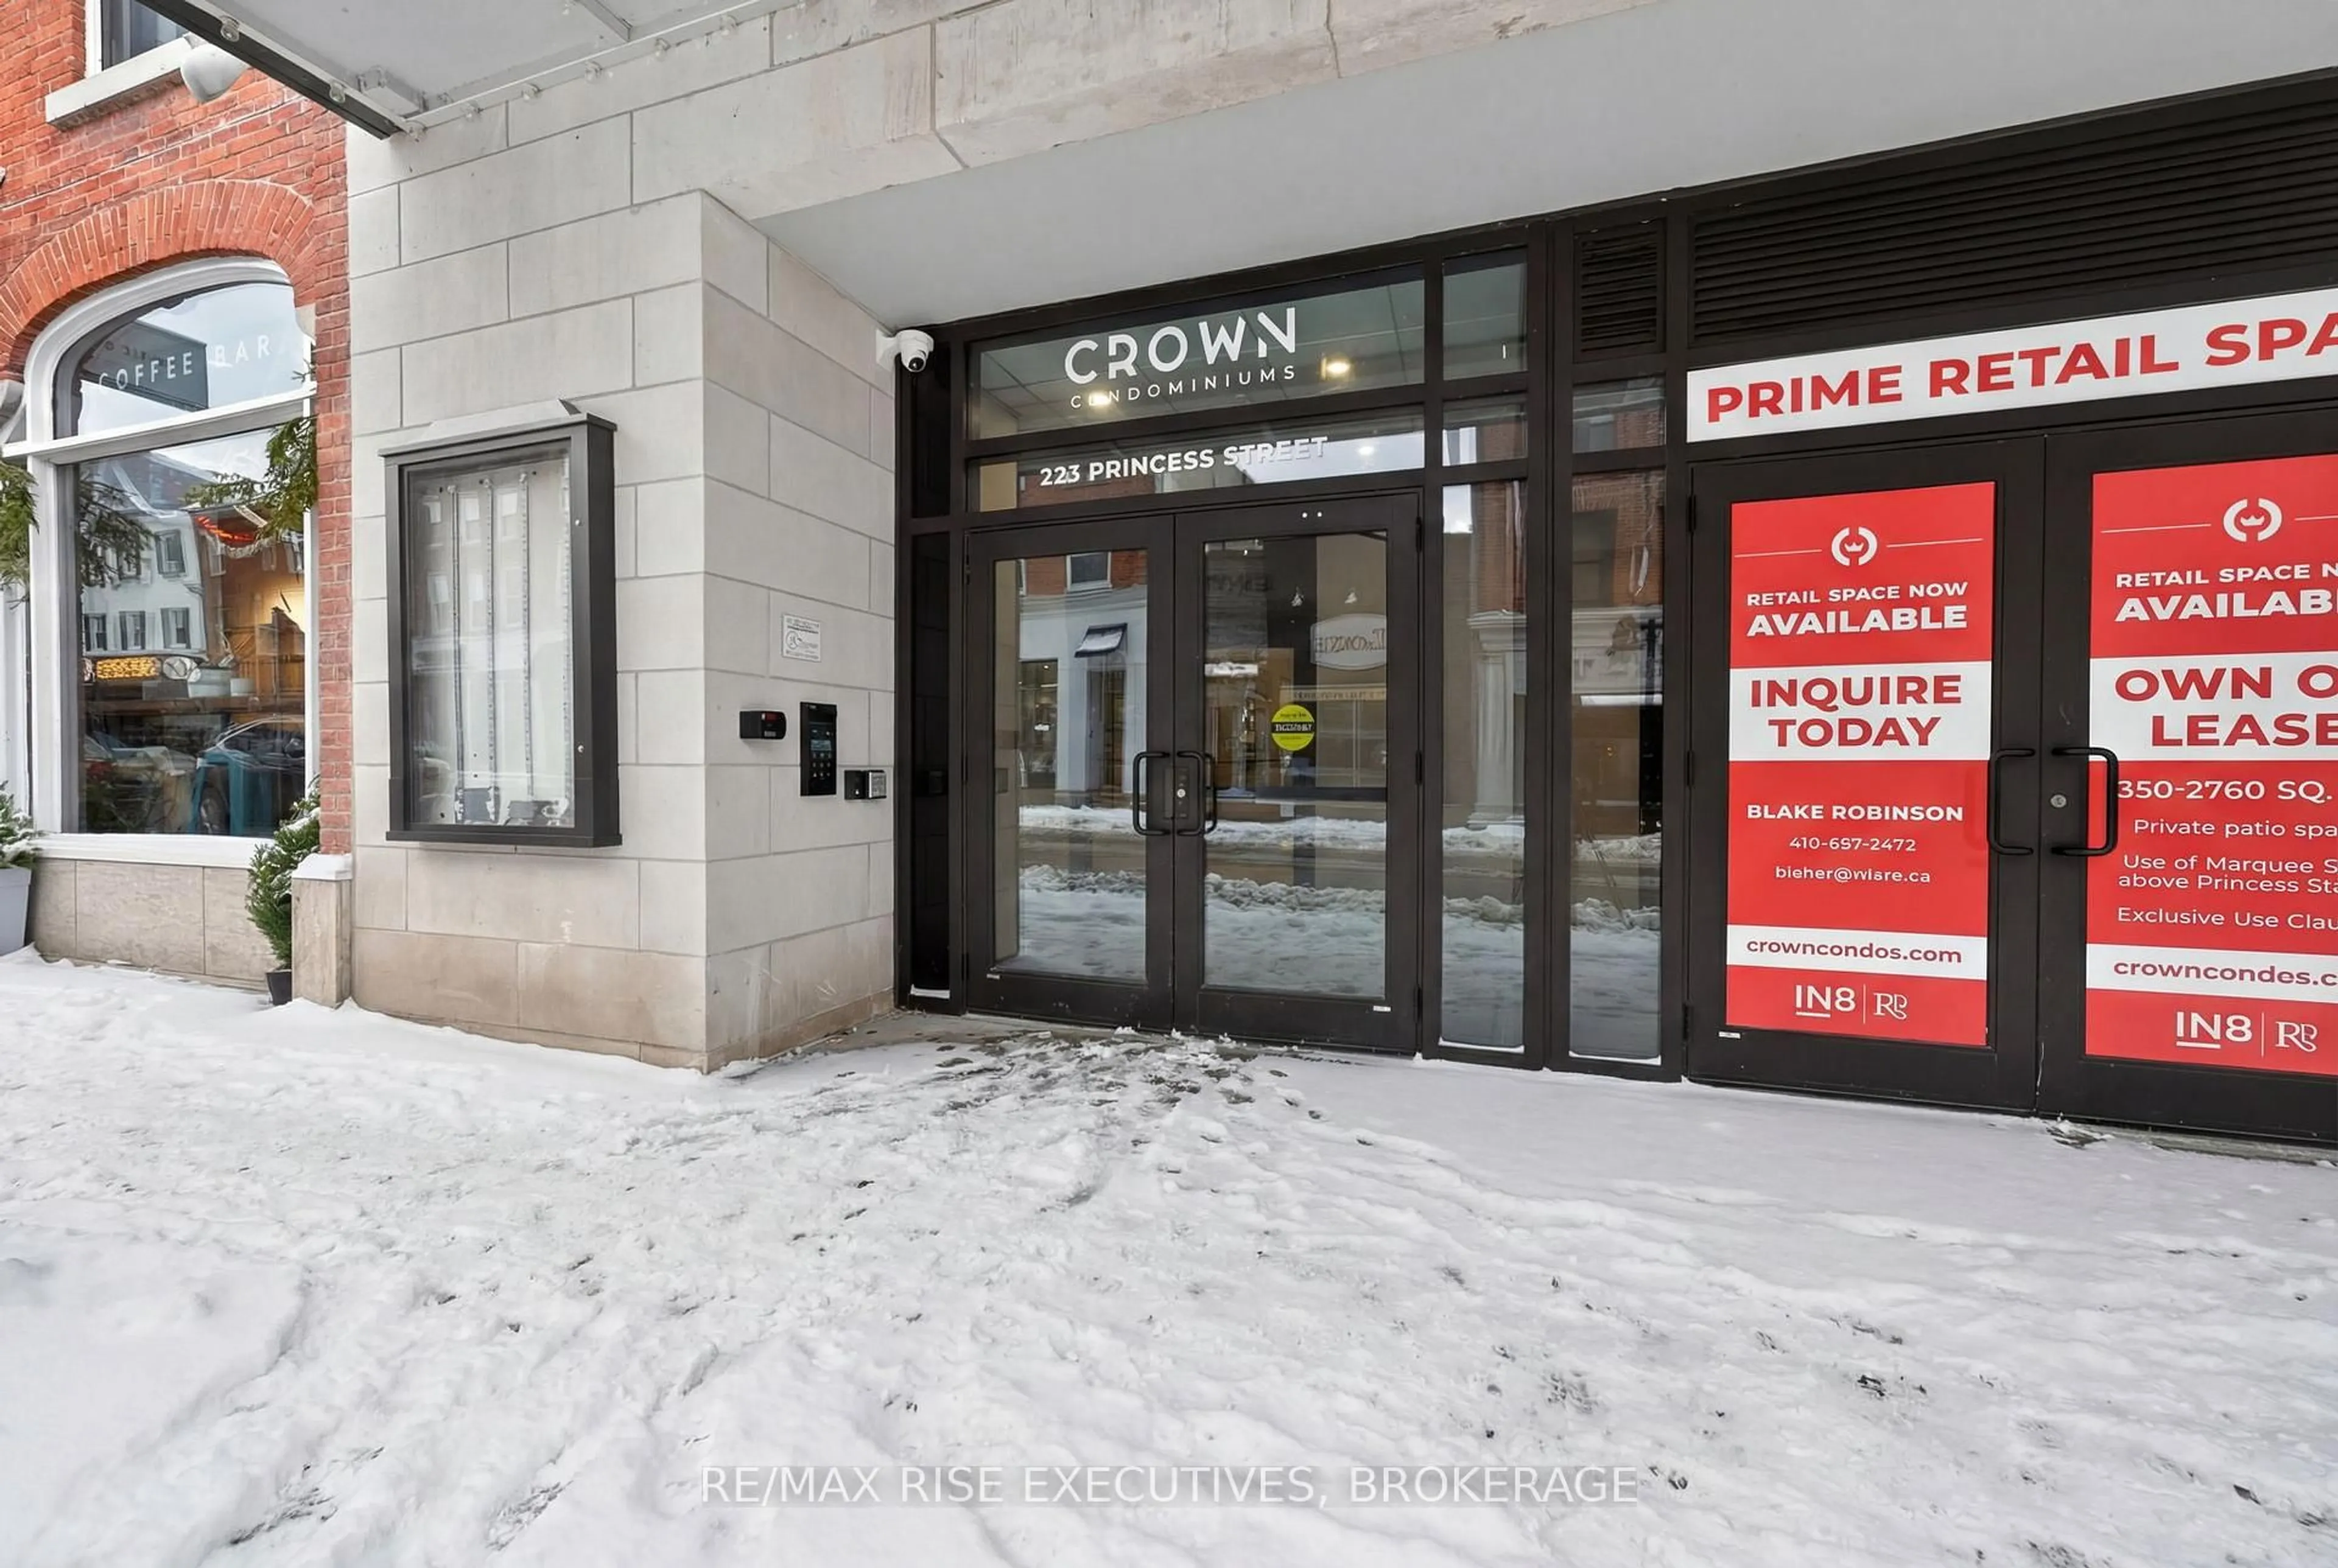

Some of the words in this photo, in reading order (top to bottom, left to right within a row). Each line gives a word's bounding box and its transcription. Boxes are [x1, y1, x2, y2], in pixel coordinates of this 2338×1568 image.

[1065, 308, 1295, 384] CROWN
[1708, 364, 1902, 423] PRIME
[1929, 334, 2179, 397] RETAIL
[1039, 464, 1080, 486] 223
[1089, 449, 1213, 481] PRINCESS
[1224, 436, 1328, 465] STREET
[2116, 569, 2210, 588] RETAIL
[2219, 564, 2311, 583] SPACE
[1747, 590, 1820, 606] RETAIL
[1828, 586, 1900, 601] SPACE
[1909, 582, 1968, 598] NOW
[1746, 605, 1968, 637] AVAILABLE
[1750, 674, 1962, 712] INQUIRE
[2115, 667, 2273, 701] OWN
[1768, 716, 1941, 747] TODAY
[2278, 781, 2333, 803] SQ.
[1747, 805, 1824, 819] BLAKE
[1832, 805, 1963, 821] ROBINSON
[2134, 819, 2215, 835] Private
[2225, 821, 2286, 838] patio
[2123, 855, 2166, 870] Use
[2174, 856, 2199, 870] of
[2206, 858, 2314, 875] Marquee
[2118, 873, 2189, 889] above
[2197, 875, 2300, 892] Princess
[2118, 908, 2225, 925] Exclusive
[2234, 912, 2280, 928] Use
[1746, 940, 1962, 964] crowncondos.com
[1794, 985, 1856, 1013] IN8
[2176, 1011, 2253, 1043] IN8
